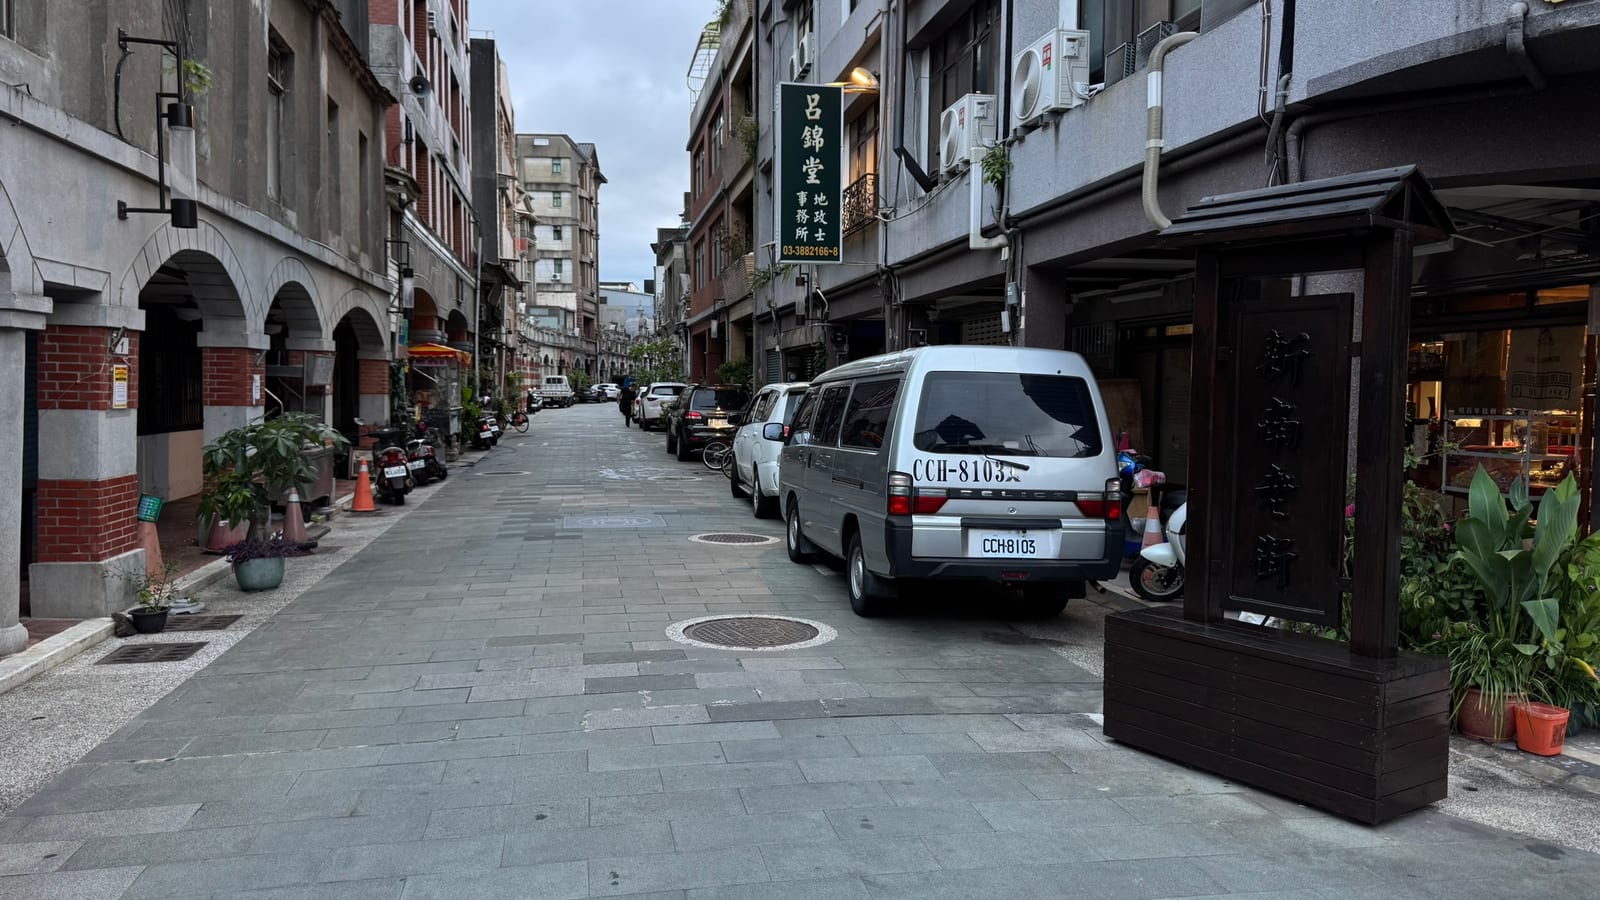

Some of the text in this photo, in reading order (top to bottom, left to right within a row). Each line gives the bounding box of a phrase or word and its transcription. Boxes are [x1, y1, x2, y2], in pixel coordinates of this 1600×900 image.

[801, 93, 825, 185] 呂錦堂
[795, 191, 810, 242] 事務所
[813, 192, 828, 241] 地政士
[783, 245, 839, 257] 03-3882166~8
[913, 459, 1005, 482] CCH-8103
